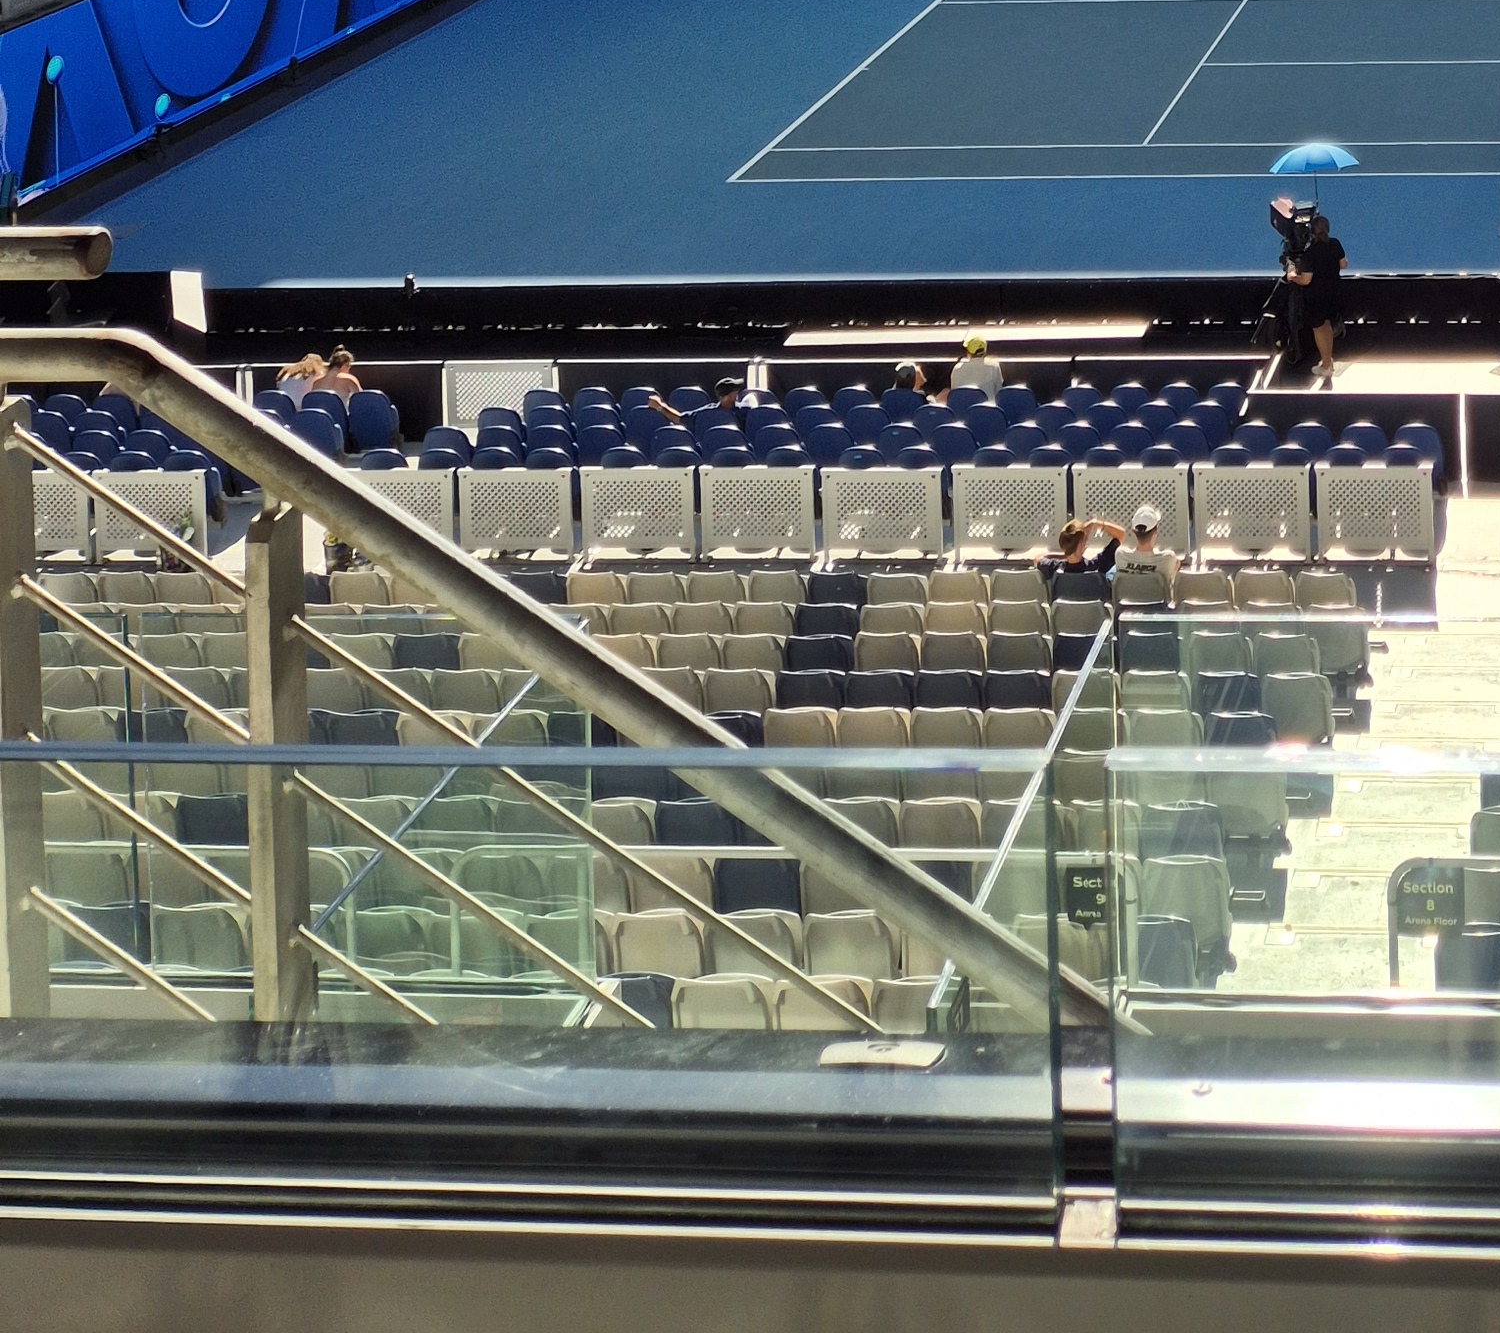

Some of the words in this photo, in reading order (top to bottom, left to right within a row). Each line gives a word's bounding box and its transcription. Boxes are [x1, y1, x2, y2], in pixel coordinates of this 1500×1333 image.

[1403, 882, 1454, 894] Section
[1095, 893, 1107, 905] 9
[1426, 899, 1435, 911] 8
[1404, 916, 1432, 925] Arena
[1433, 917, 1458, 925] Floor
